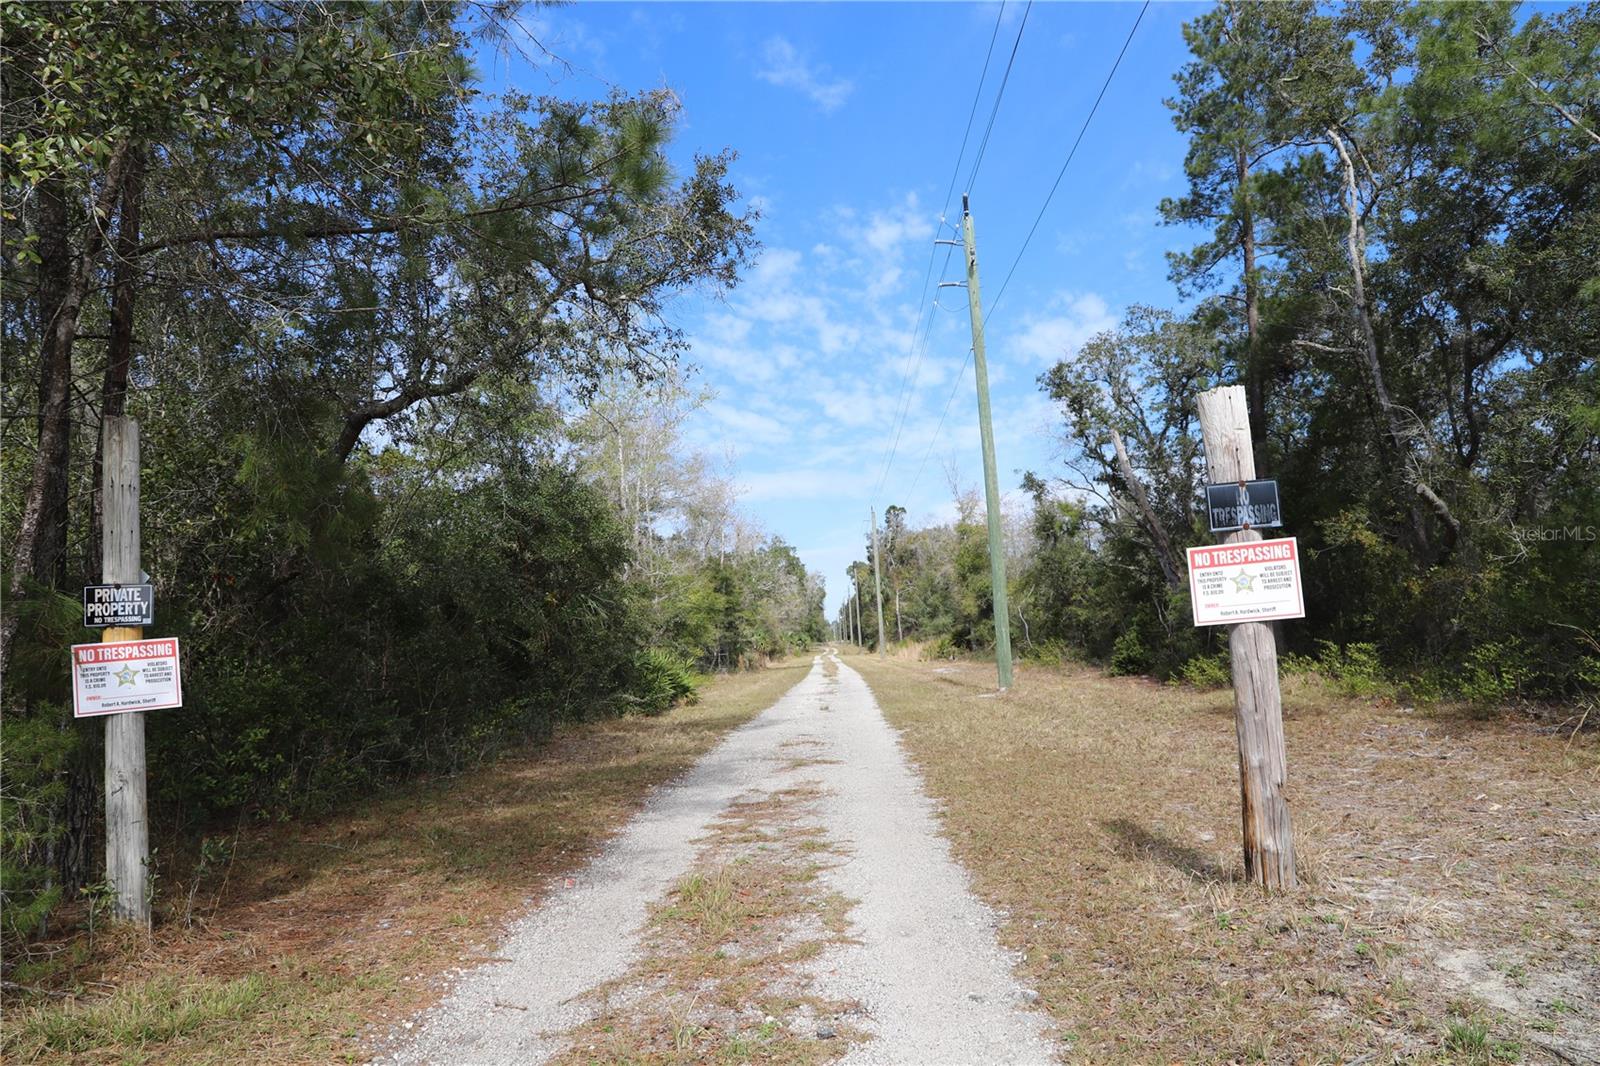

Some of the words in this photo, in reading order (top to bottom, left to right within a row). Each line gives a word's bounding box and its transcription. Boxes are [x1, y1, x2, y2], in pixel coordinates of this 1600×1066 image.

[1235, 486, 1250, 505] NO
[1212, 503, 1278, 527] TRESPASSING
[1194, 552, 1211, 566] NO
[1213, 544, 1291, 565] TRESPASSING
[94, 588, 142, 602] PRIVATE
[87, 601, 148, 617] PROPERTY
[78, 648, 95, 662] NO
[97, 643, 172, 661] TRESPASSING
